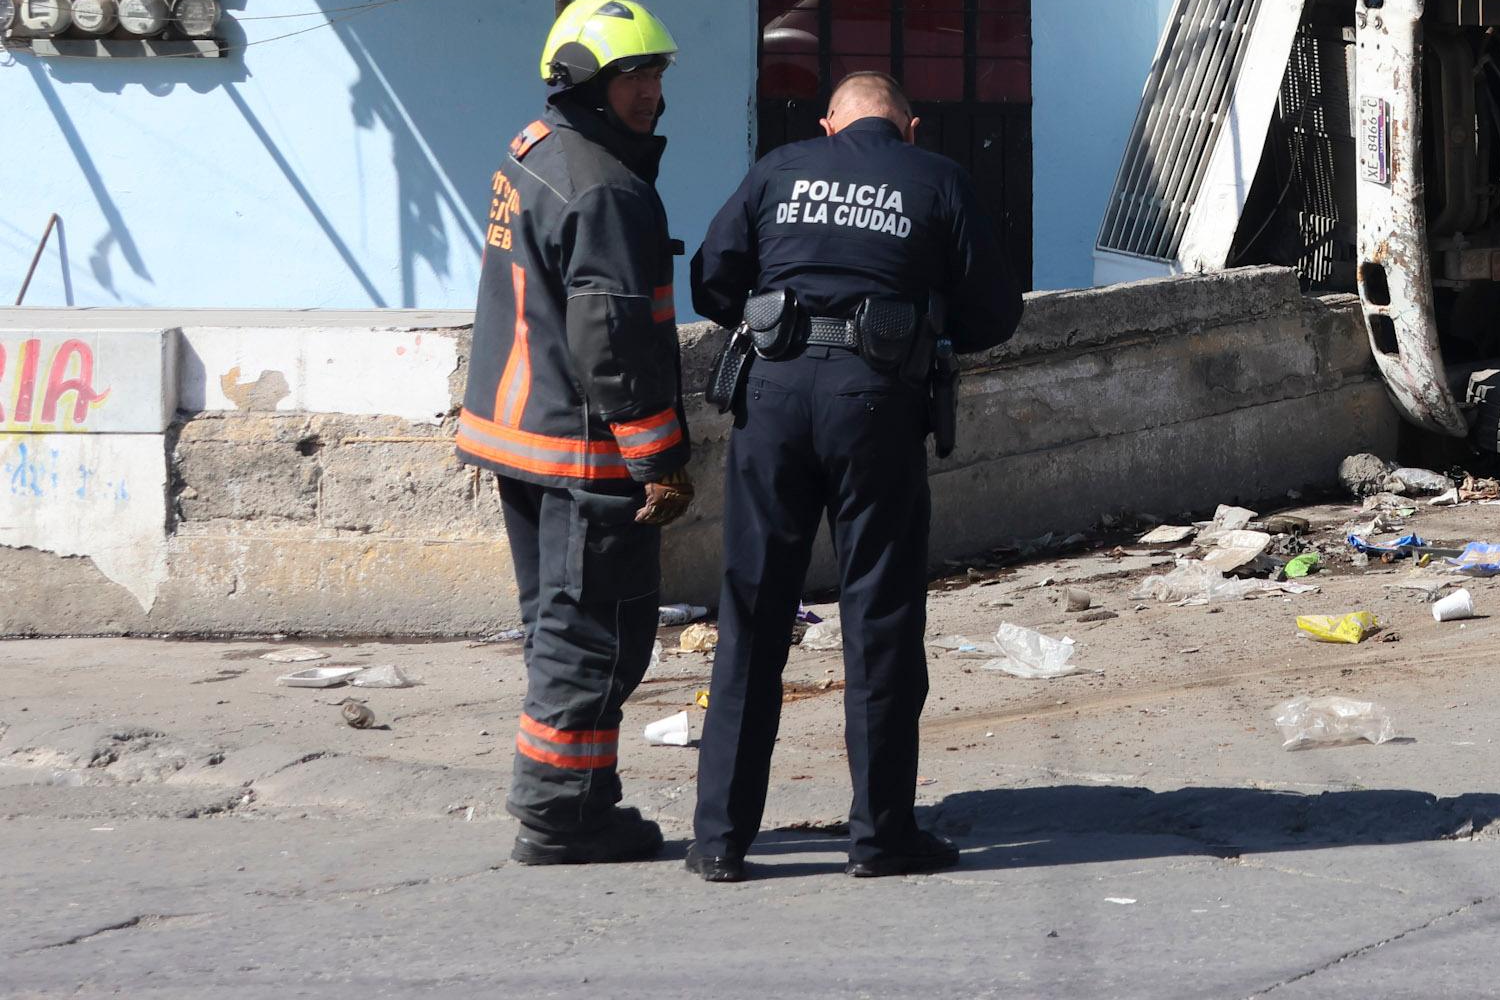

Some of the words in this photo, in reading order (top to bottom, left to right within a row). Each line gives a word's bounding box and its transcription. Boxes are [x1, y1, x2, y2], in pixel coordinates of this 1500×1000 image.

[1367, 99, 1379, 178] XE-8466-C
[791, 180, 903, 213] POLICÍA
[776, 202, 800, 224] DE
[803, 202, 828, 224] LA
[834, 205, 912, 239] CIUDAD
